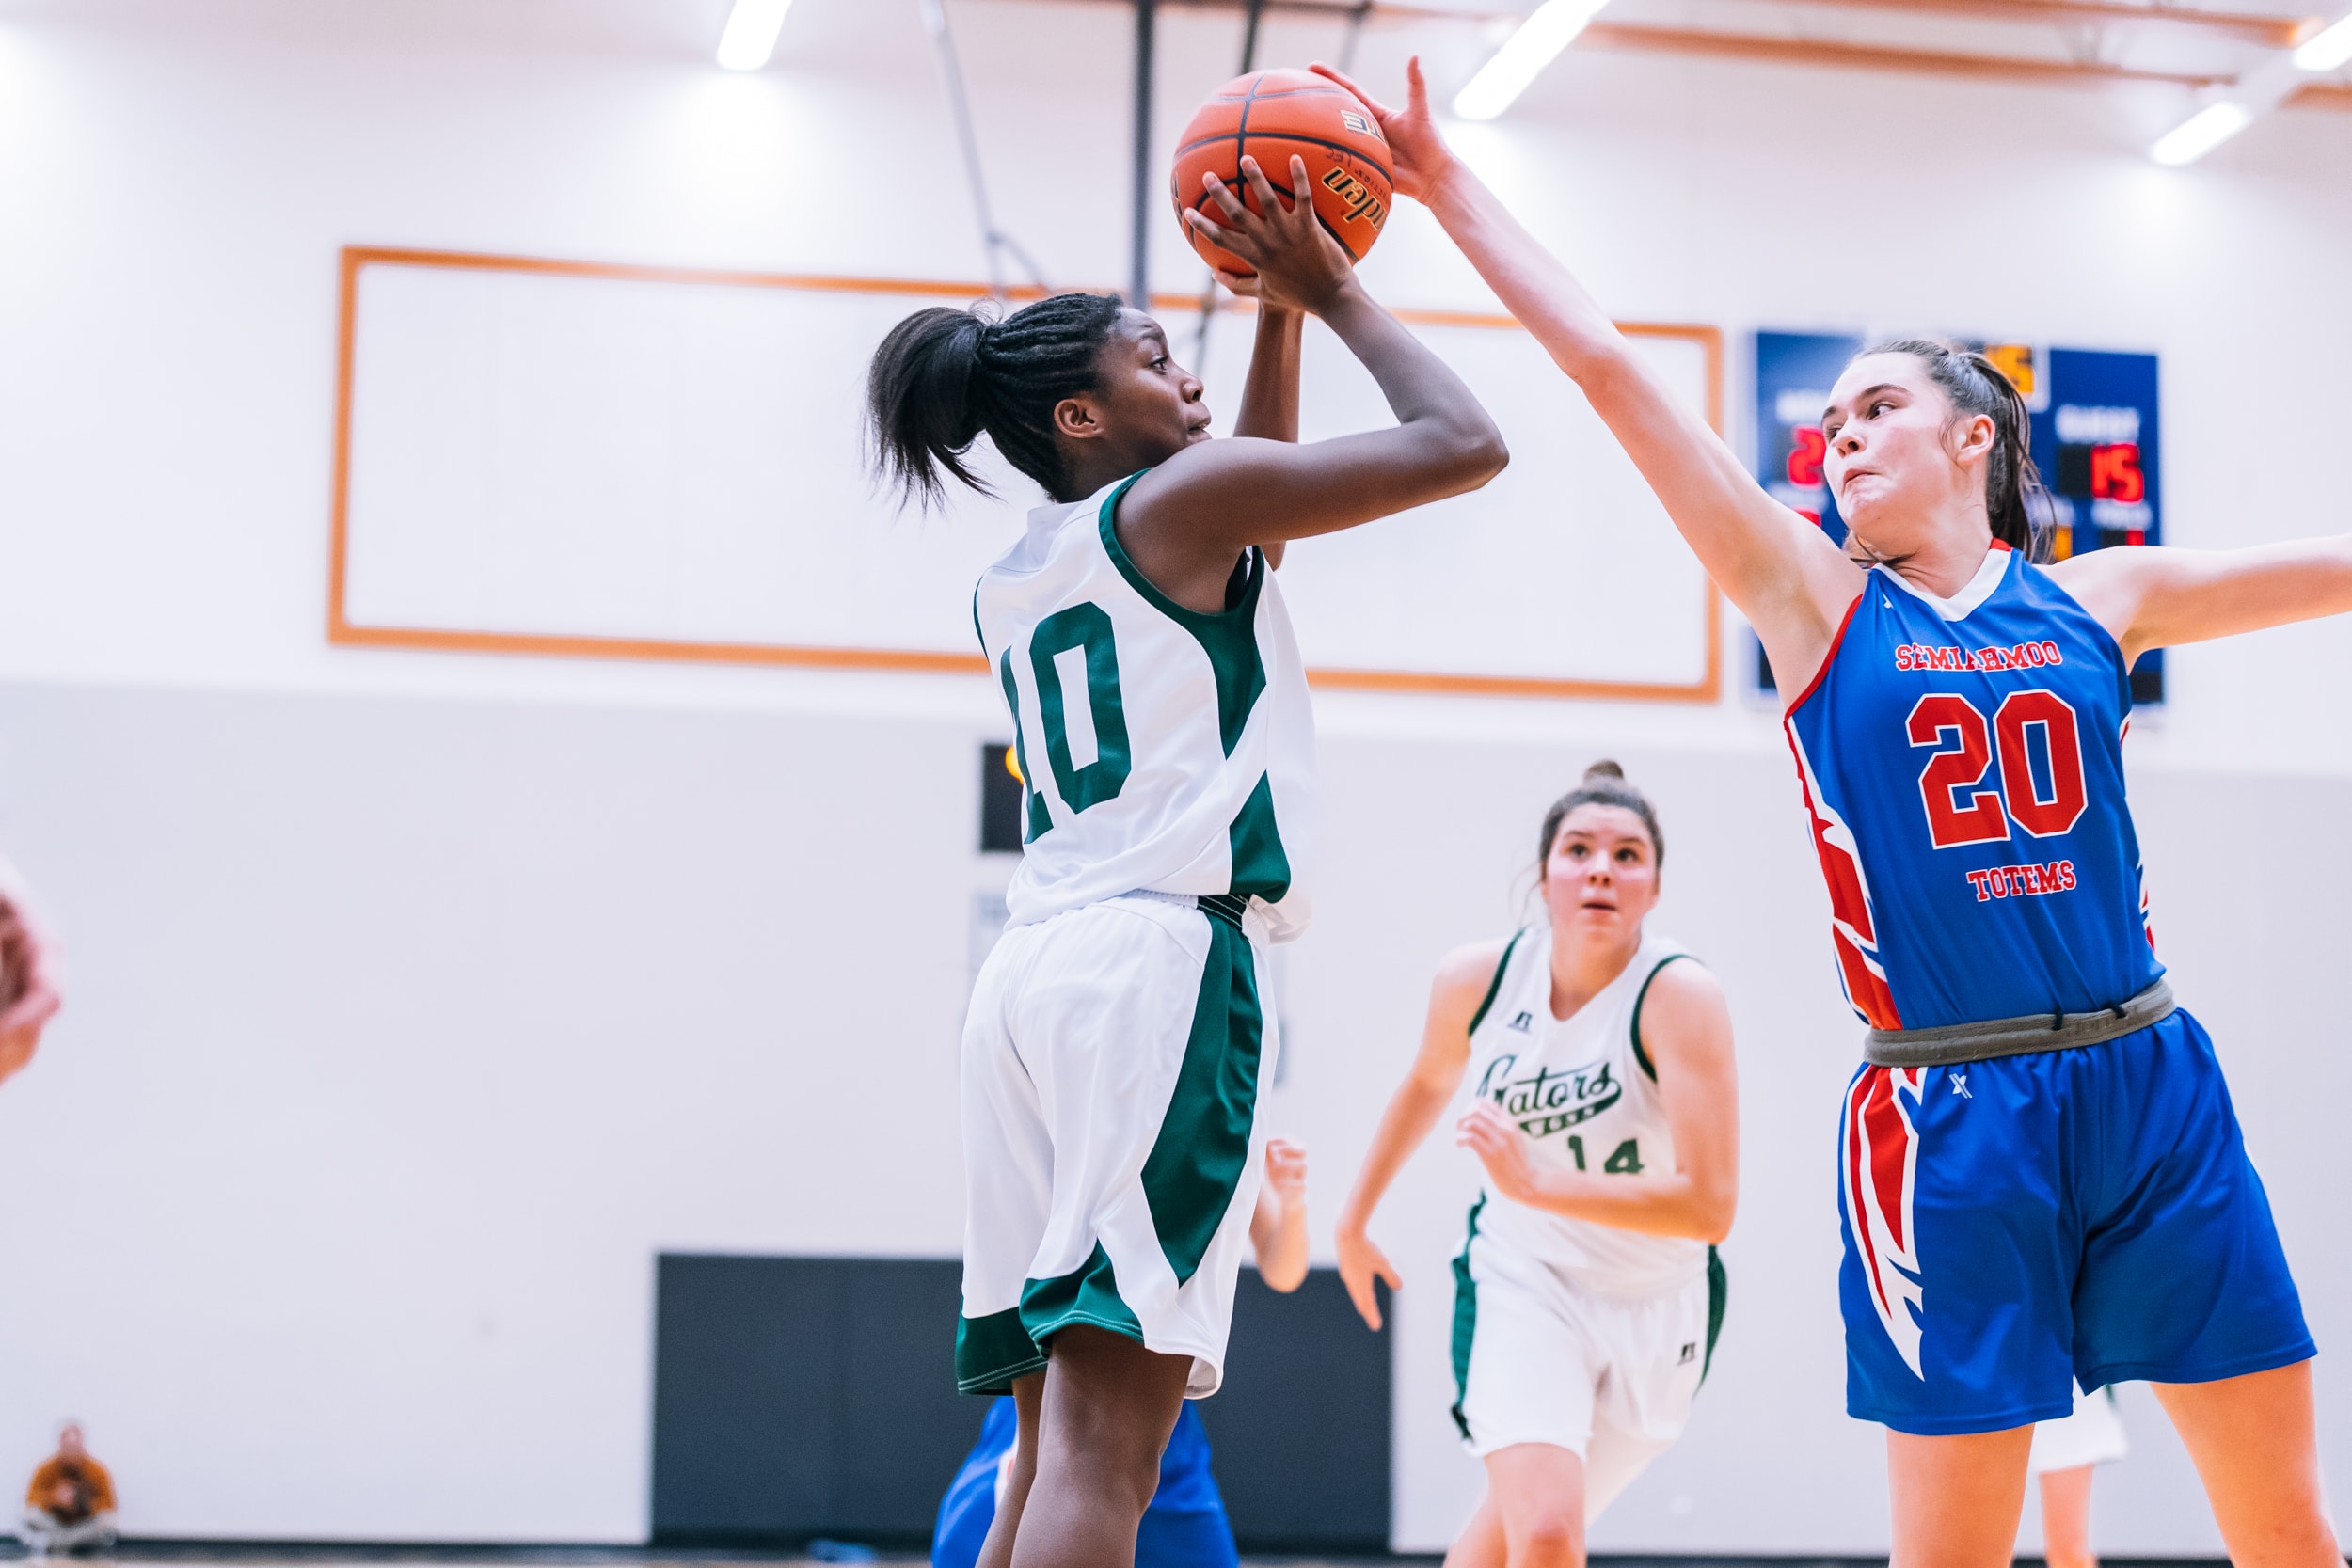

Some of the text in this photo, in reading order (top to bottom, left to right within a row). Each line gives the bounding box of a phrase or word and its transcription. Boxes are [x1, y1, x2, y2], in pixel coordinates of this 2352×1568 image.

[1895, 640, 2063, 673] SEMIAHMOO
[1000, 600, 1132, 845] 10
[1905, 689, 2089, 850] 20
[1965, 859, 2077, 902] TOTEMS
[1475, 1053, 1611, 1116] Gators
[1567, 1134, 1645, 1175] 14
